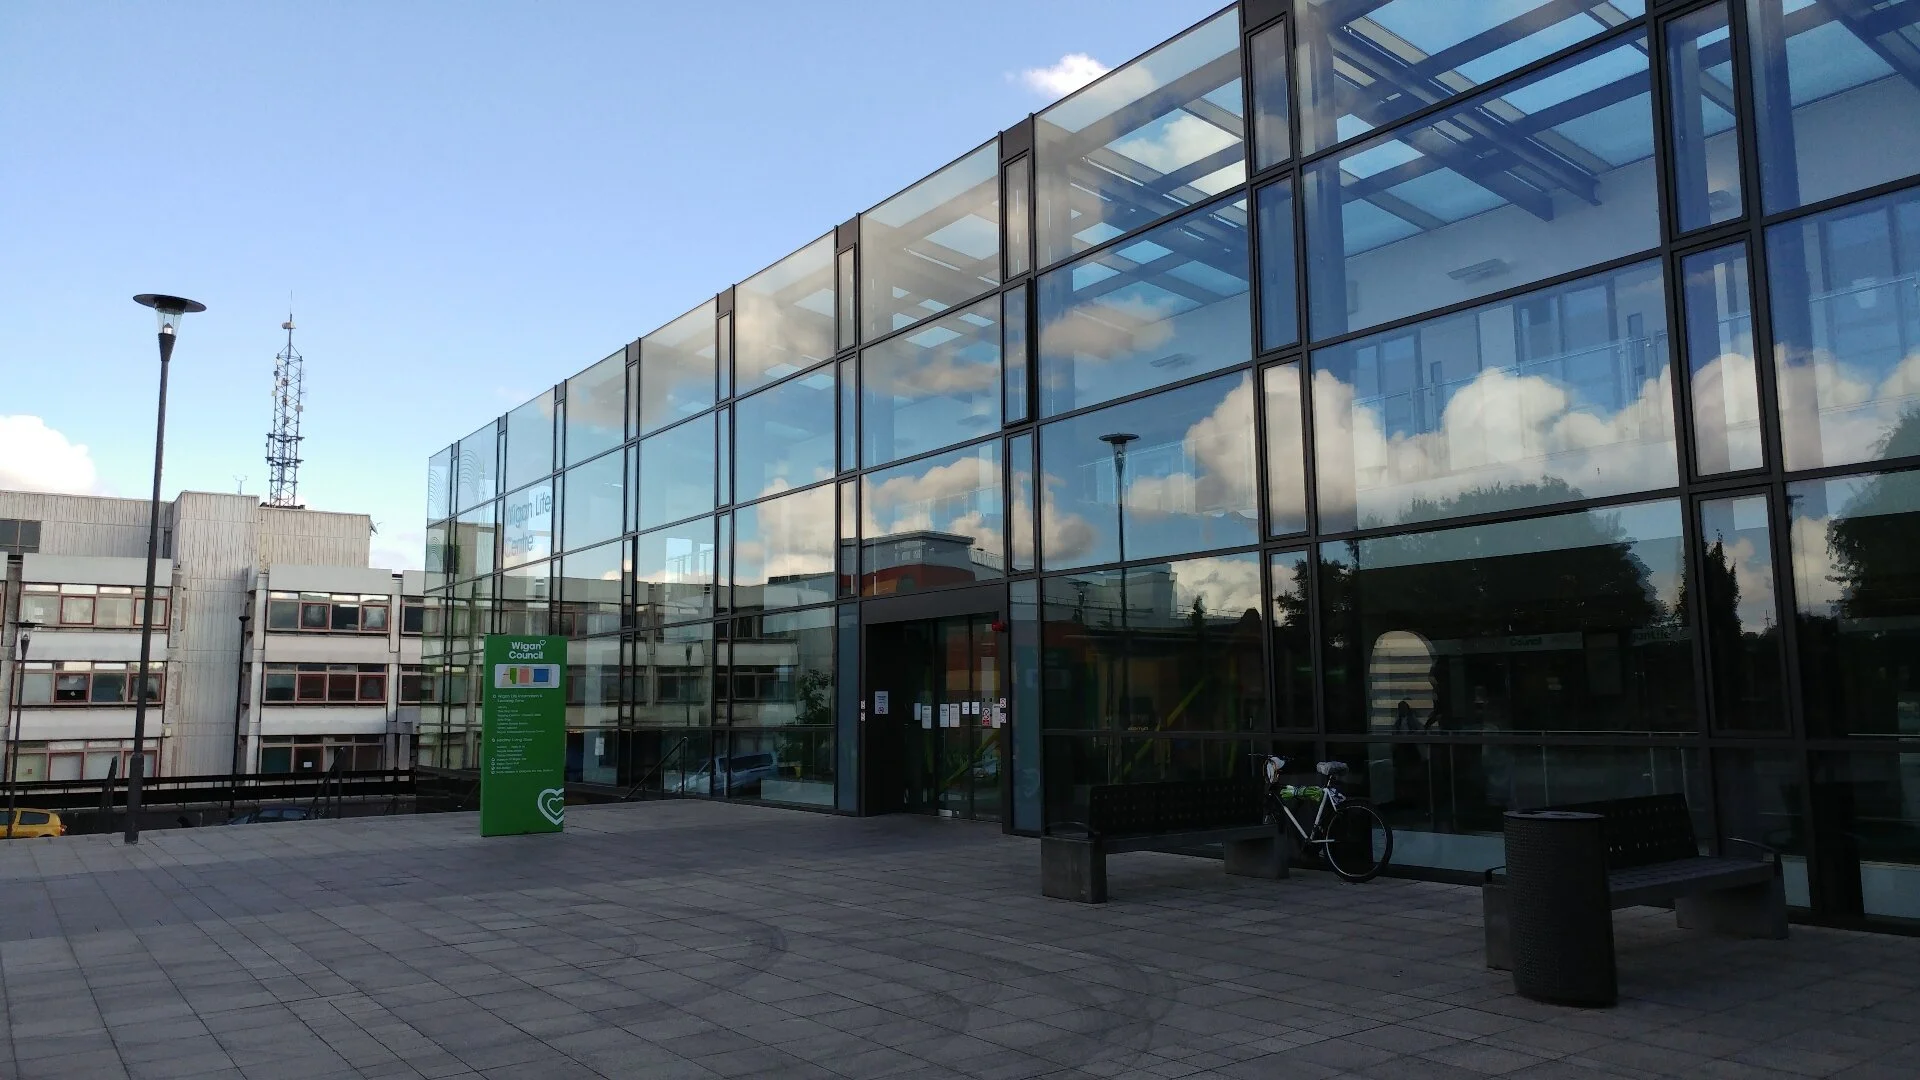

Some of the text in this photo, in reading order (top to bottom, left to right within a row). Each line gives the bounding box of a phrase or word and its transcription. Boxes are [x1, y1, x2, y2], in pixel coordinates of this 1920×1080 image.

[506, 492, 551, 528] Wigan Life
[504, 532, 534, 557] Centre
[508, 651, 544, 660] Council
[511, 641, 542, 652] Wigan
